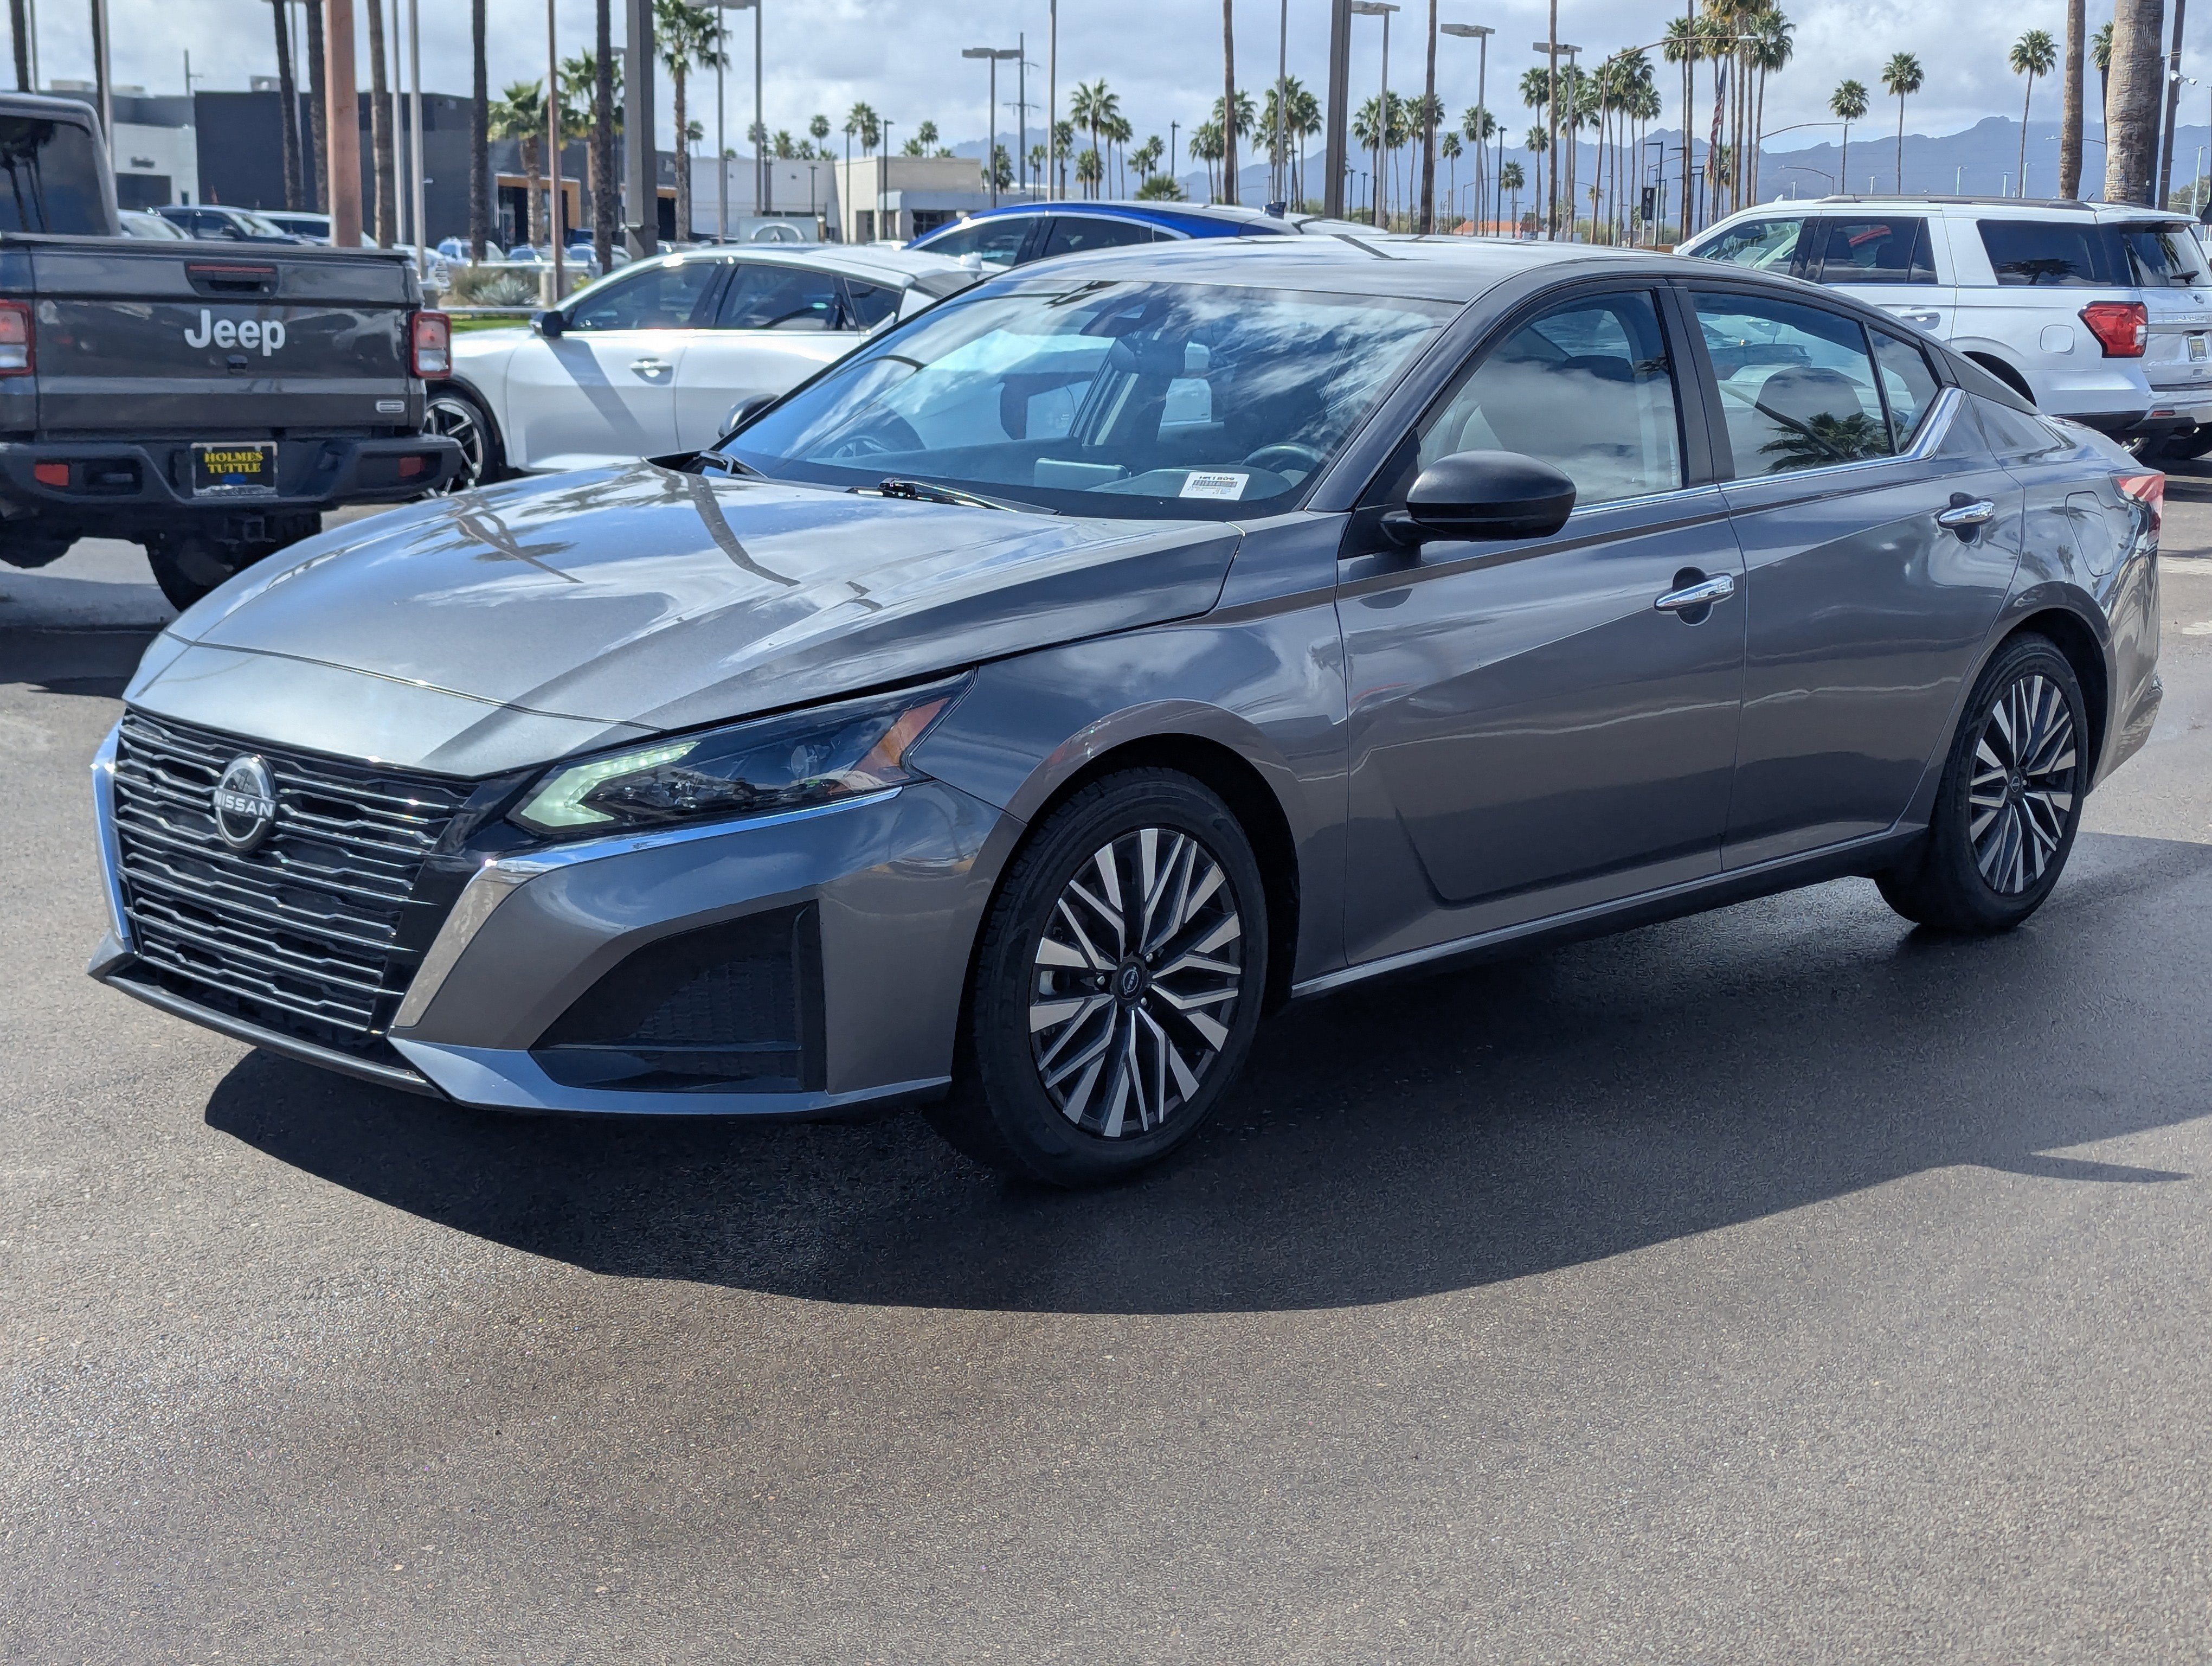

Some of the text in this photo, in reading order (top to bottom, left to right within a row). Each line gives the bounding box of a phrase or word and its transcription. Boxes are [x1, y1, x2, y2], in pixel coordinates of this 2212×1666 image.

[184, 309, 285, 356] Jeep
[204, 452, 263, 463] HOLMES
[208, 463, 261, 473] TUTTLE
[214, 790, 274, 817] NISSAN
